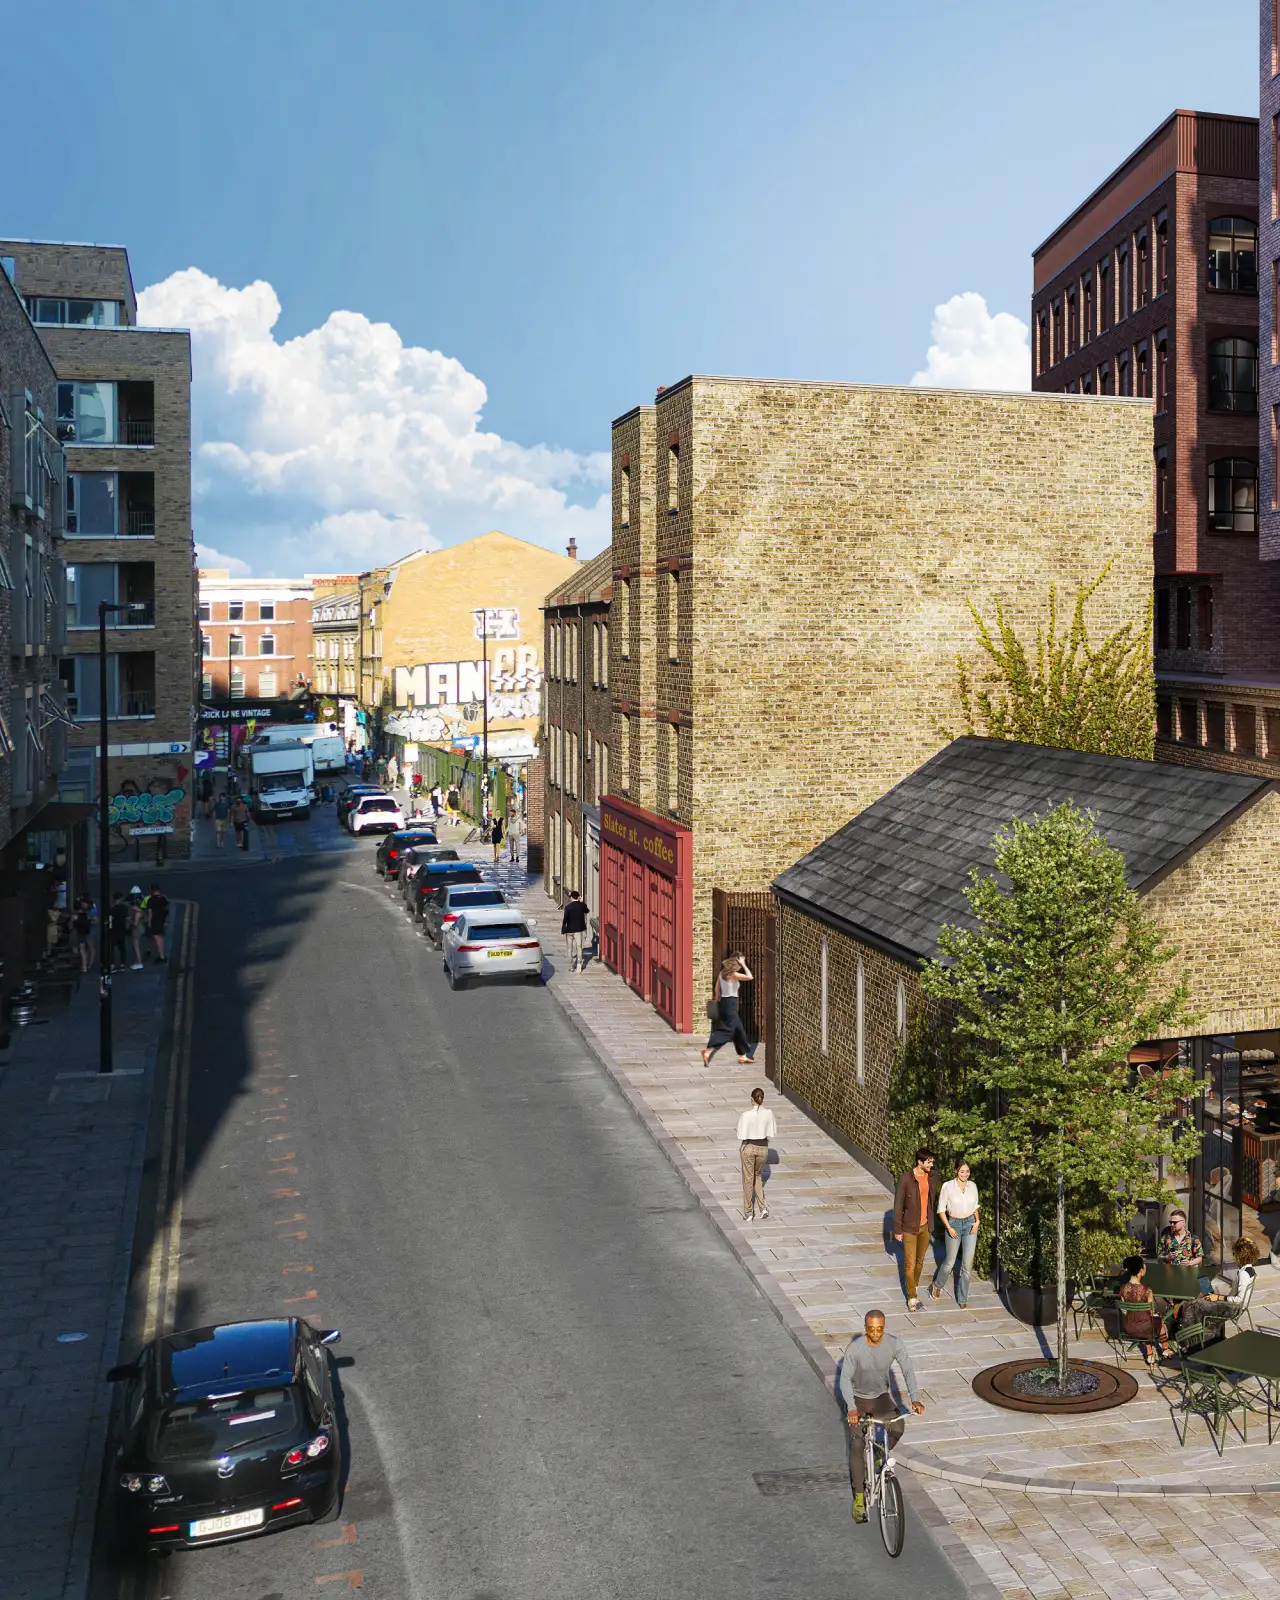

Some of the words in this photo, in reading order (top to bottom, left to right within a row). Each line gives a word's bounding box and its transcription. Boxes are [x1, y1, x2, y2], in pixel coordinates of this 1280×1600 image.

[392, 660, 492, 710] MAN
[203, 710, 221, 719] RICK
[241, 708, 271, 717] VINTAGE
[603, 813, 627, 839] Slater
[643, 837, 674, 864] coffee
